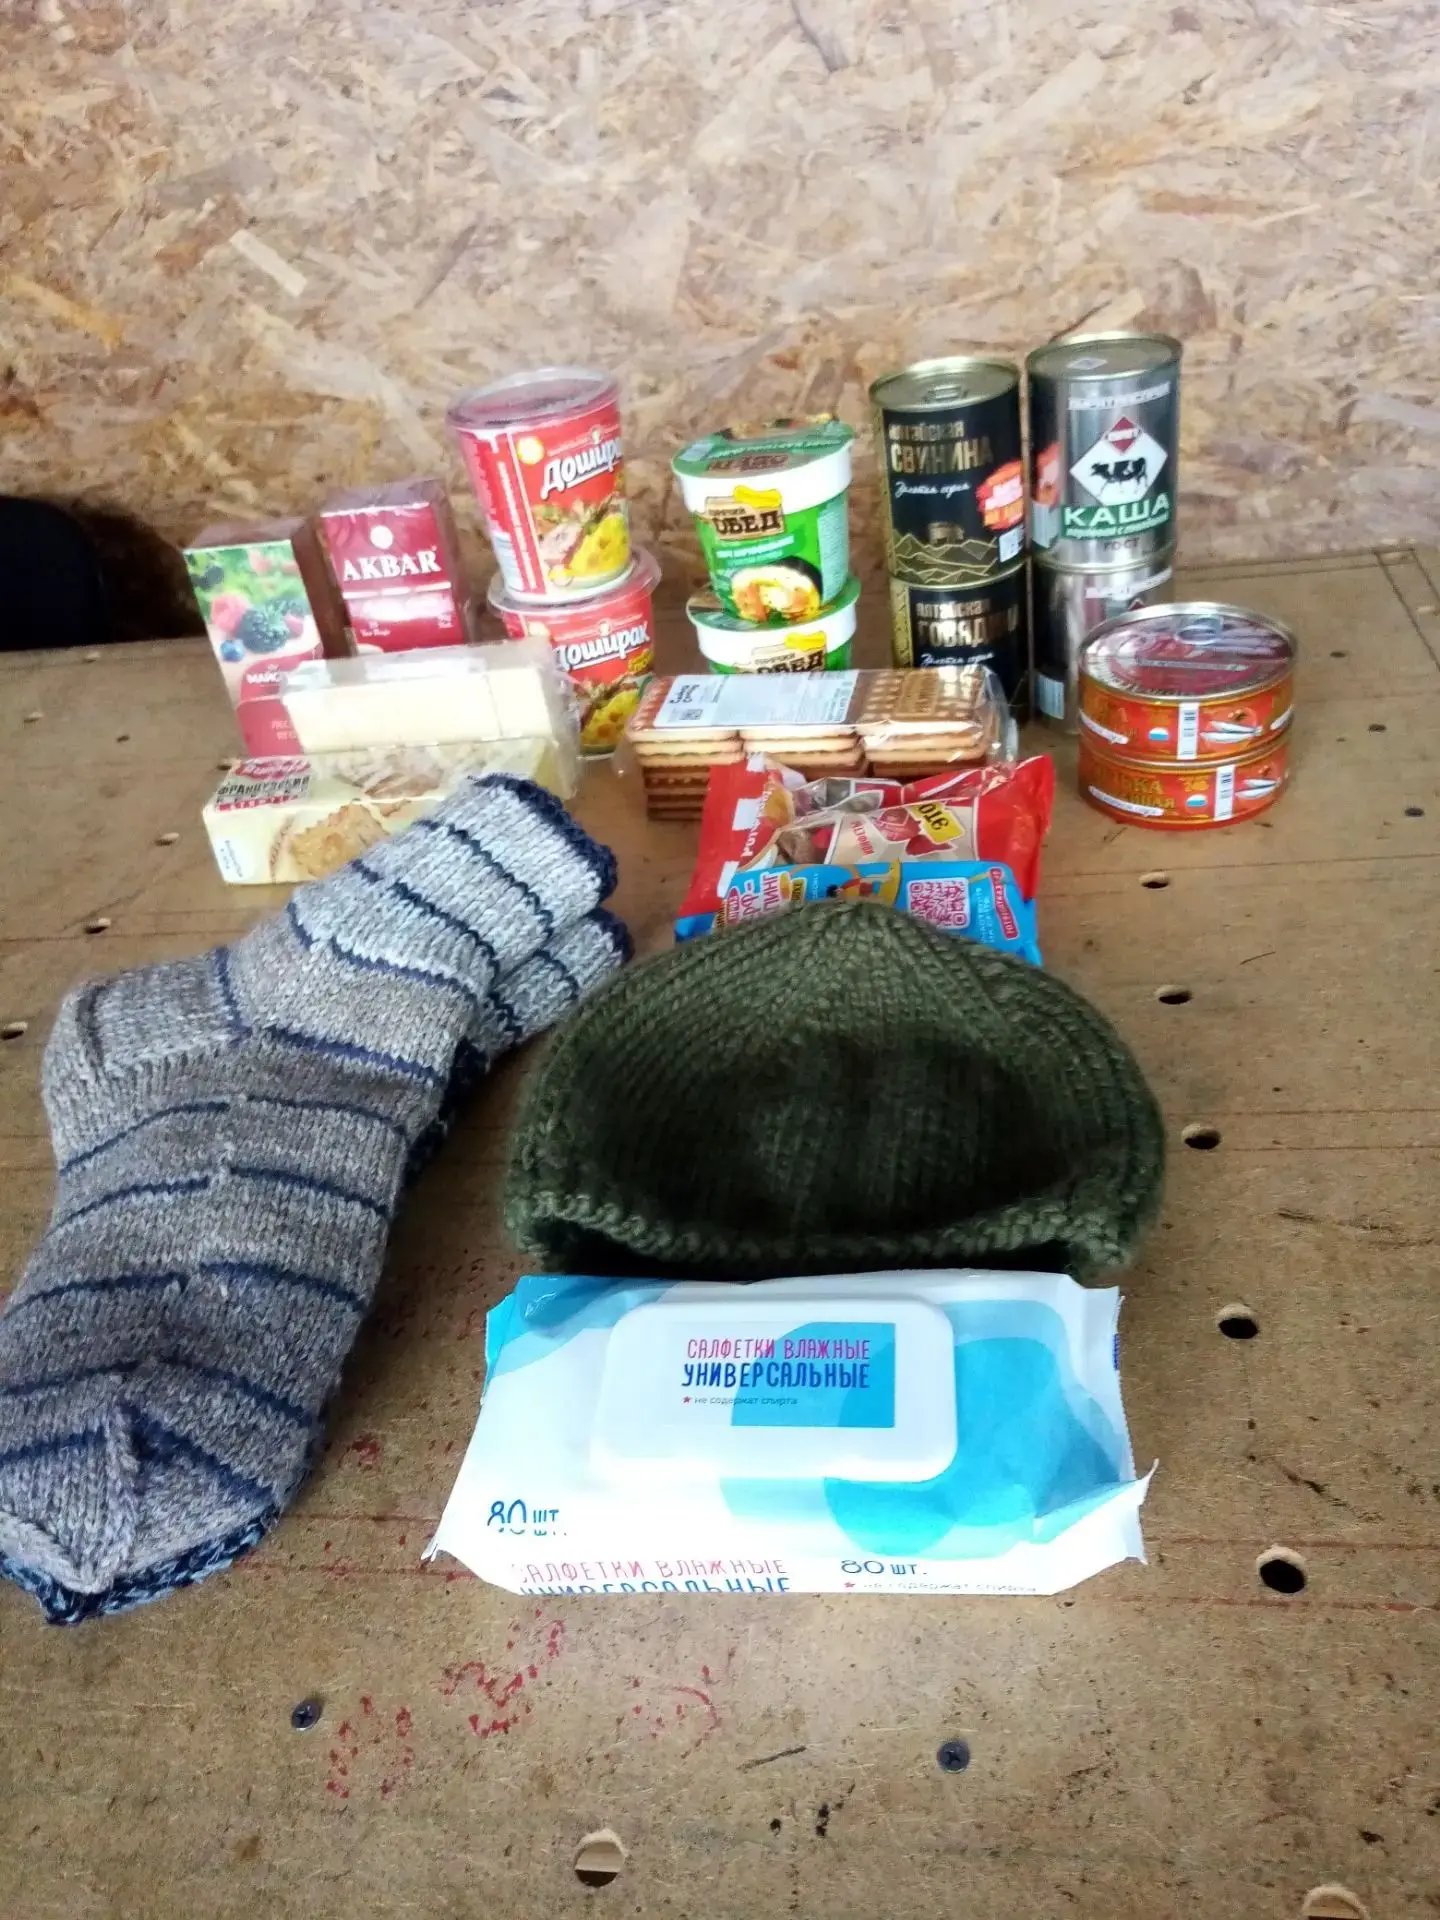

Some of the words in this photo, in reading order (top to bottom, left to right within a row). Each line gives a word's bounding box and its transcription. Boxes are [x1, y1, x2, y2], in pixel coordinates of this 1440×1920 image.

[1064, 493, 1170, 528] КАША
[343, 549, 442, 582] AKBAR
[687, 1338, 776, 1360] САЛФЕТКИ
[783, 1338, 872, 1361] ВЛАЖНЫЕ
[681, 1361, 872, 1390] УНИВЕРСАЛЬНЫЕ
[694, 1396, 708, 1404] не
[709, 1396, 758, 1406] содержат
[760, 1396, 799, 1406] спирта
[840, 1559, 885, 1575] 80
